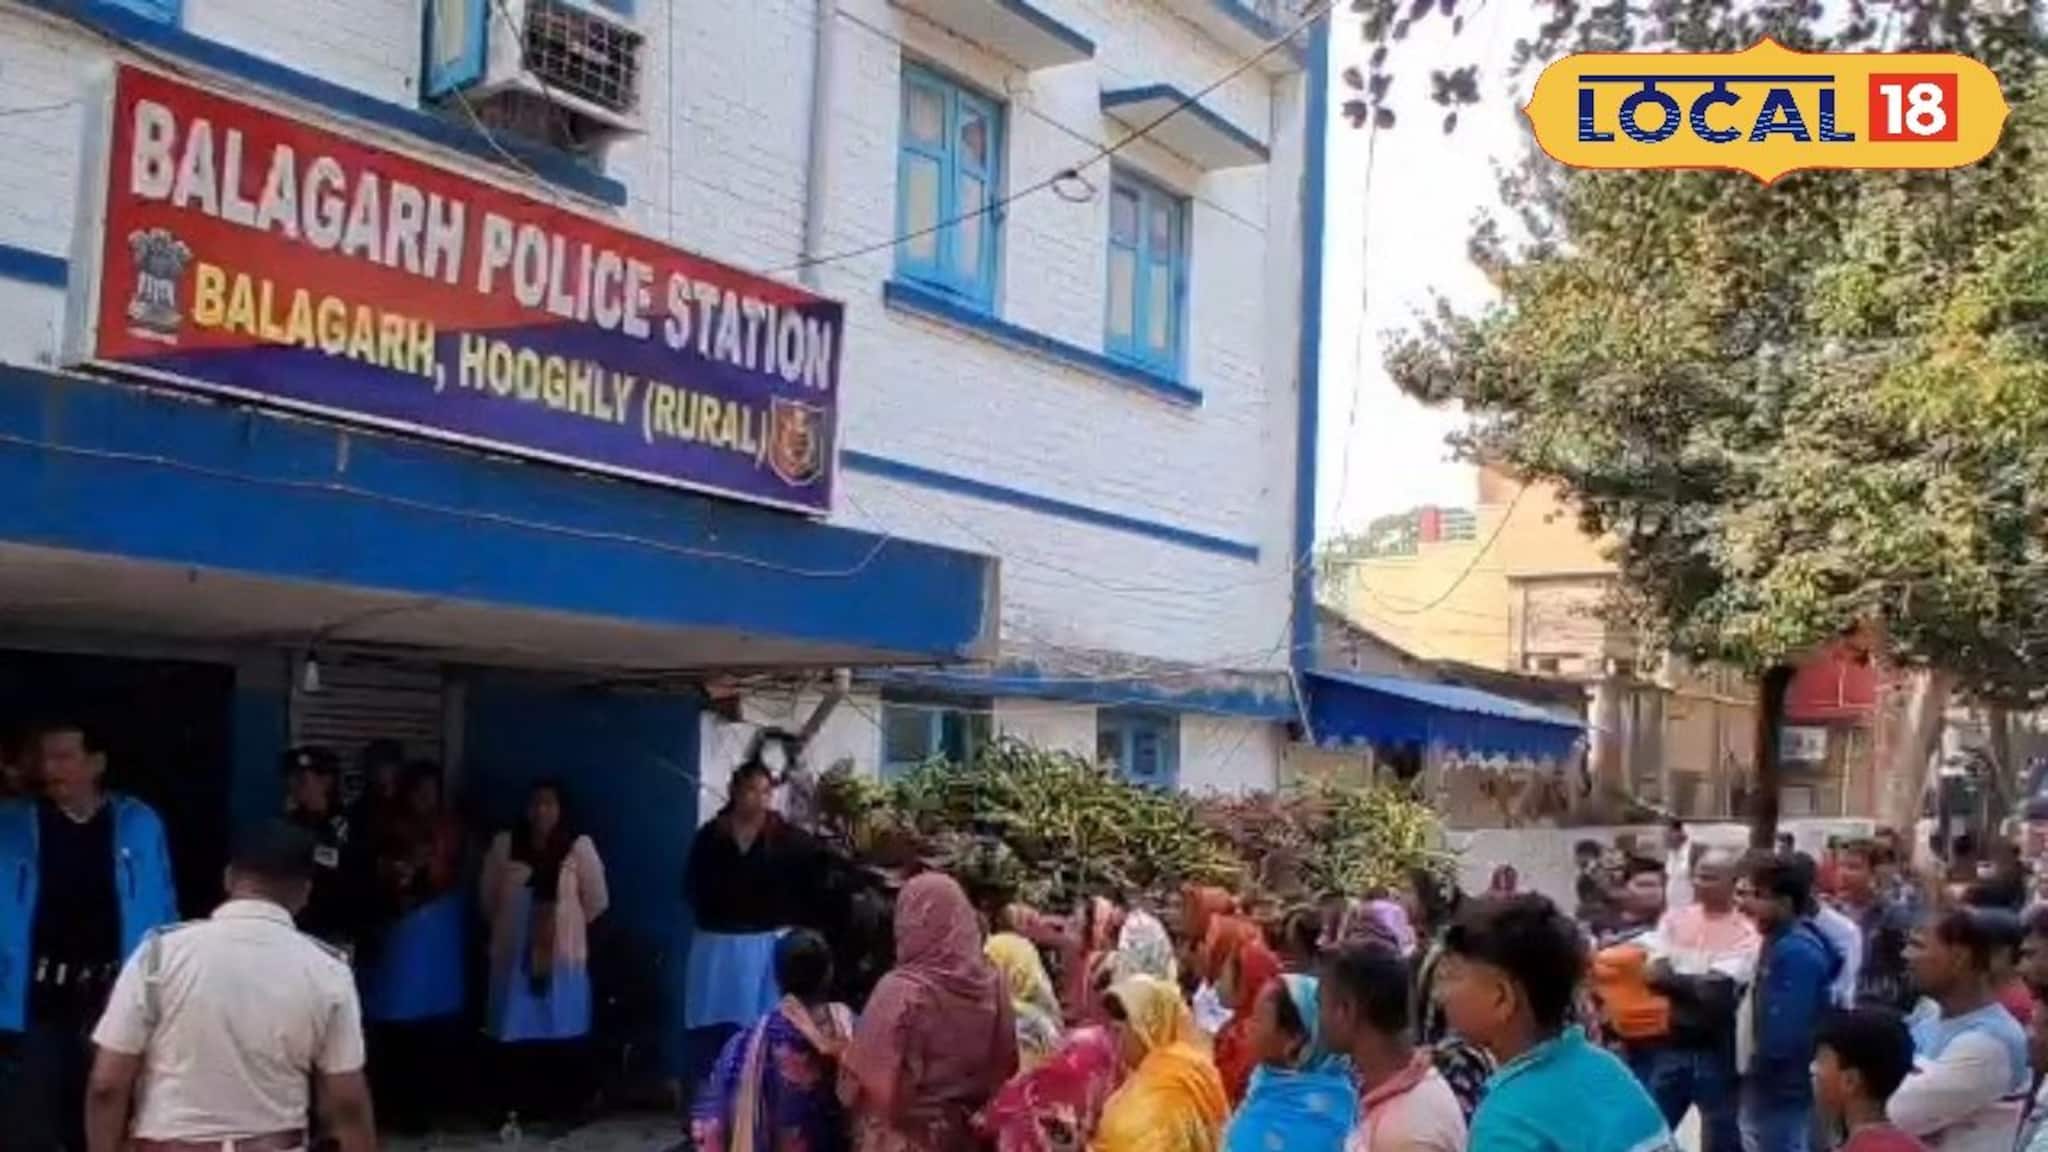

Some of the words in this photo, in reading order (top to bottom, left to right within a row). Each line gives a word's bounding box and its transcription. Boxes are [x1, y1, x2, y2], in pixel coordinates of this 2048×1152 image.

[131, 99, 465, 285] BALAGARH
[478, 213, 654, 339] POLICE
[664, 271, 832, 390] STATION
[193, 263, 446, 390] BALAGARH,
[642, 380, 767, 470] (RURAL)
